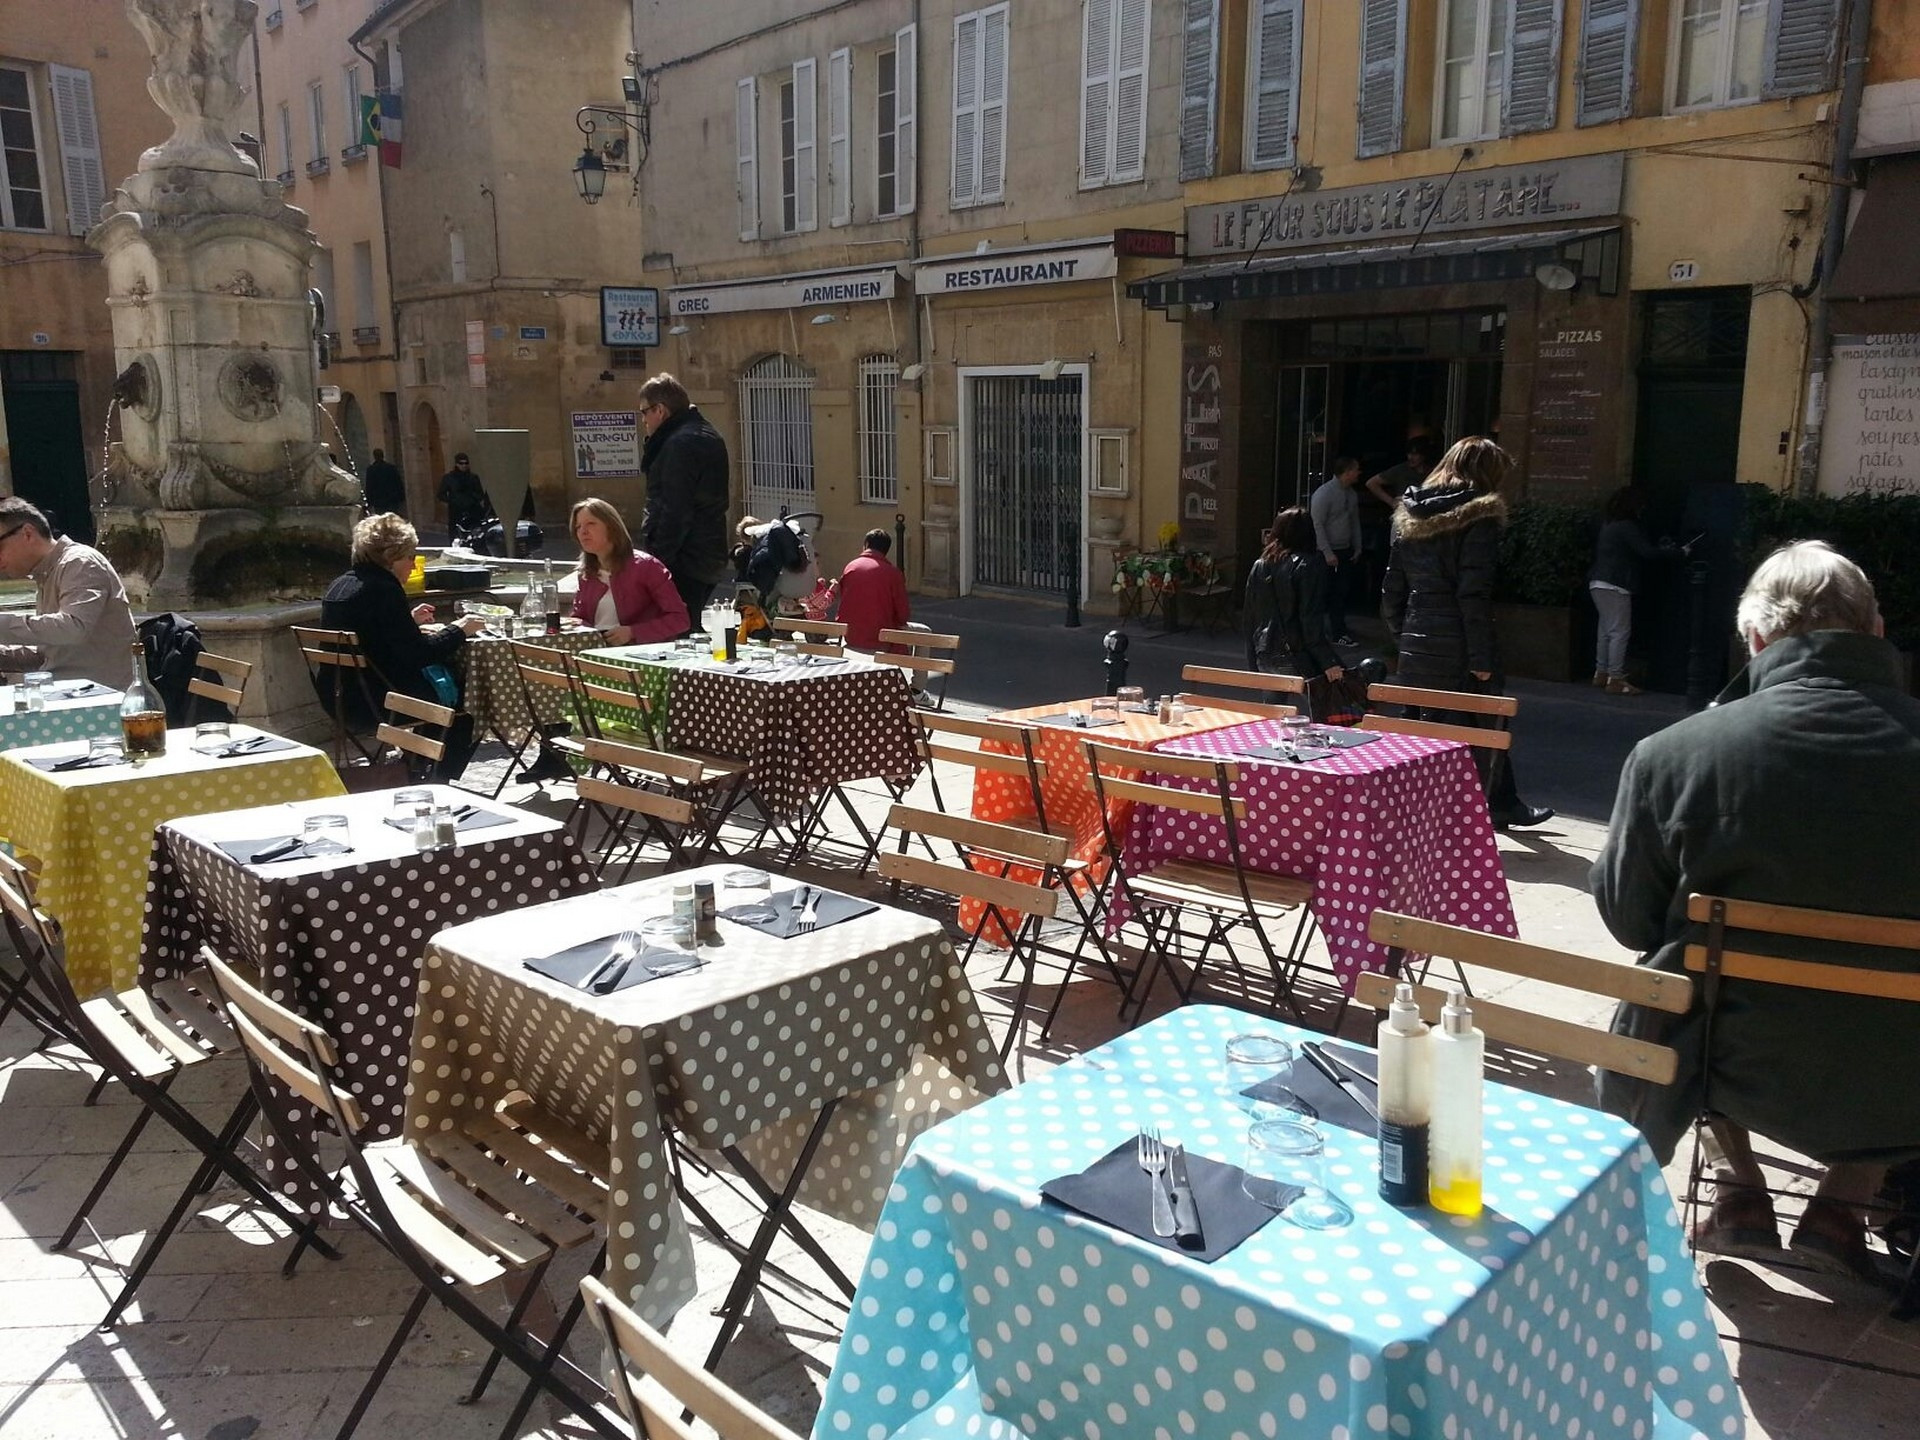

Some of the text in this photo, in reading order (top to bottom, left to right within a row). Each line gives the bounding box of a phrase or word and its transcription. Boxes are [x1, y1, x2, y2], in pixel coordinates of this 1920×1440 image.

[1213, 211, 1235, 248] LE
[1239, 202, 1306, 249] FOUR
[1311, 194, 1375, 239] SOUS
[1381, 188, 1411, 231] LE
[944, 259, 1078, 289] RESTAURANT
[608, 292, 653, 303] Restaurant
[678, 281, 882, 313] GREC ARMENIEN
[1557, 329, 1602, 343] PIZZAS
[1539, 347, 1577, 359] SALADES
[1841, 348, 1882, 360] maison
[1882, 346, 1896, 359] et
[1864, 406, 1914, 422] tartes
